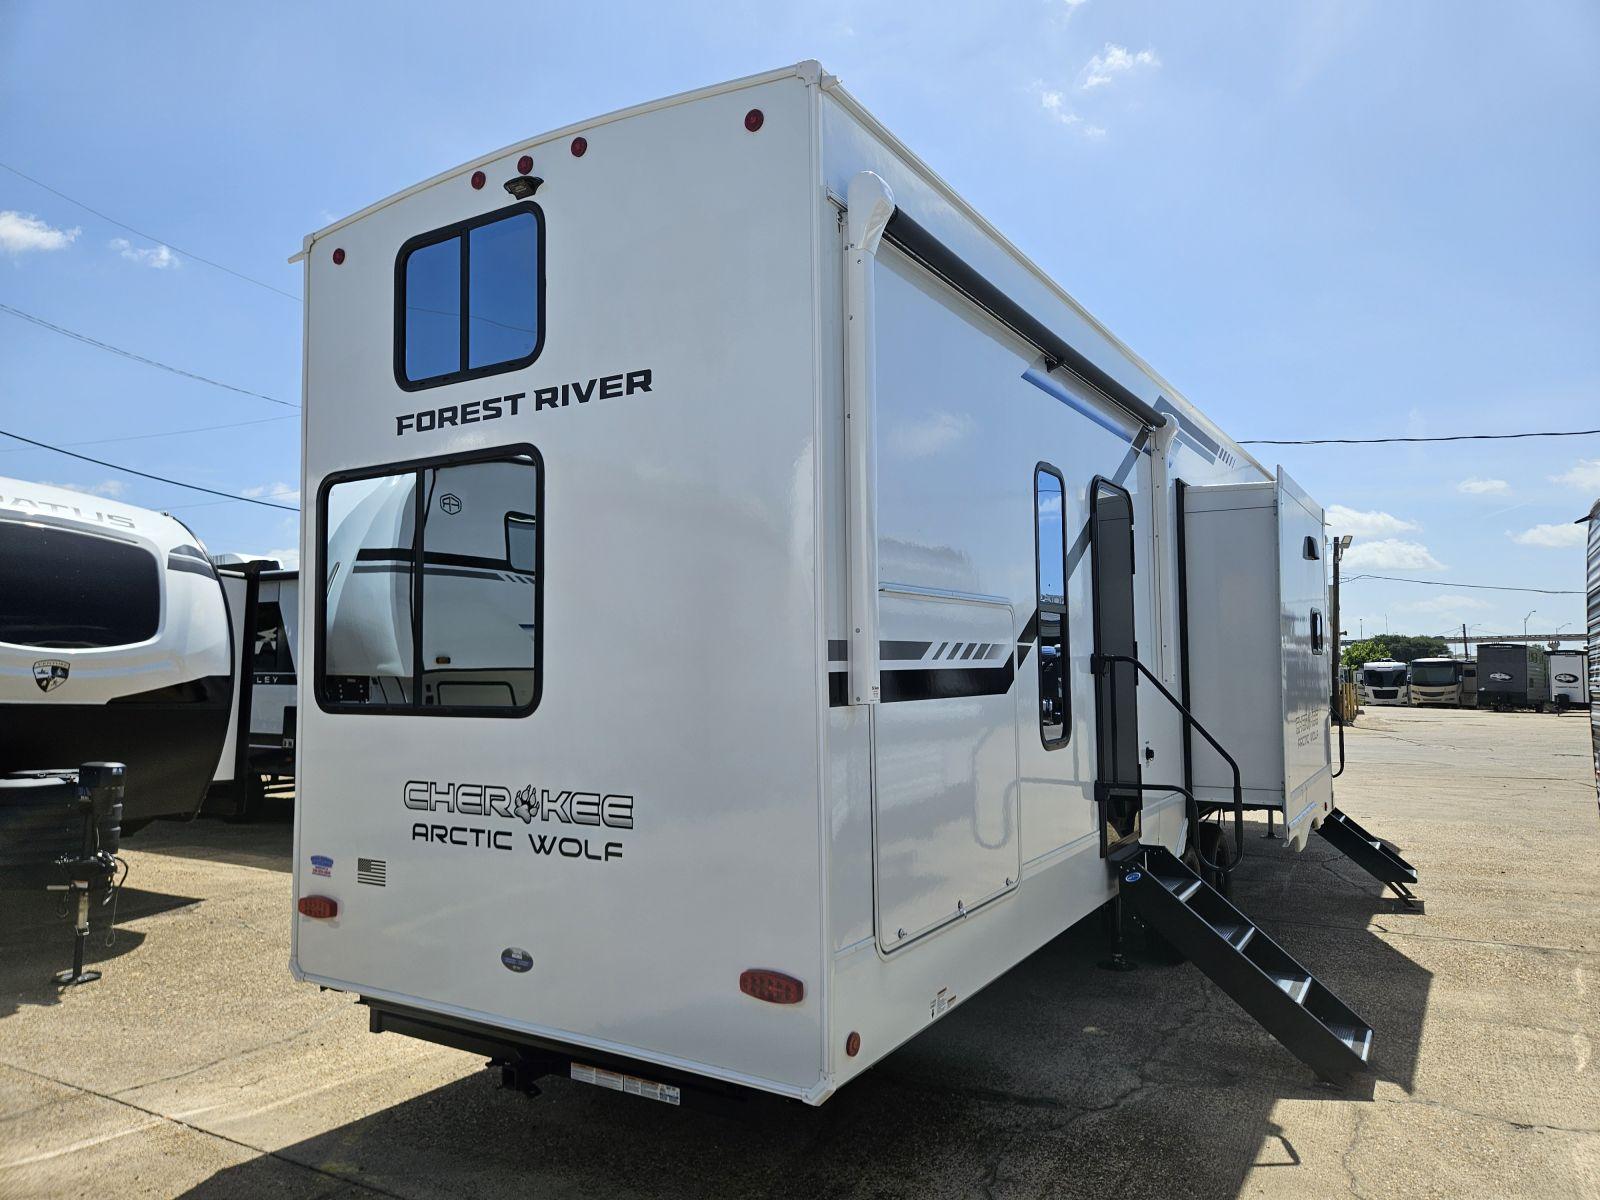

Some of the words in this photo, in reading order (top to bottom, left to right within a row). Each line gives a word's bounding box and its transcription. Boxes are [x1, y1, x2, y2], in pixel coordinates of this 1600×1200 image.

[396, 392, 525, 436] FOREST
[534, 368, 653, 411] RIVER
[0, 495, 136, 528] ATUS
[412, 822, 513, 851] ARCTIC
[528, 833, 623, 862] WOLF
